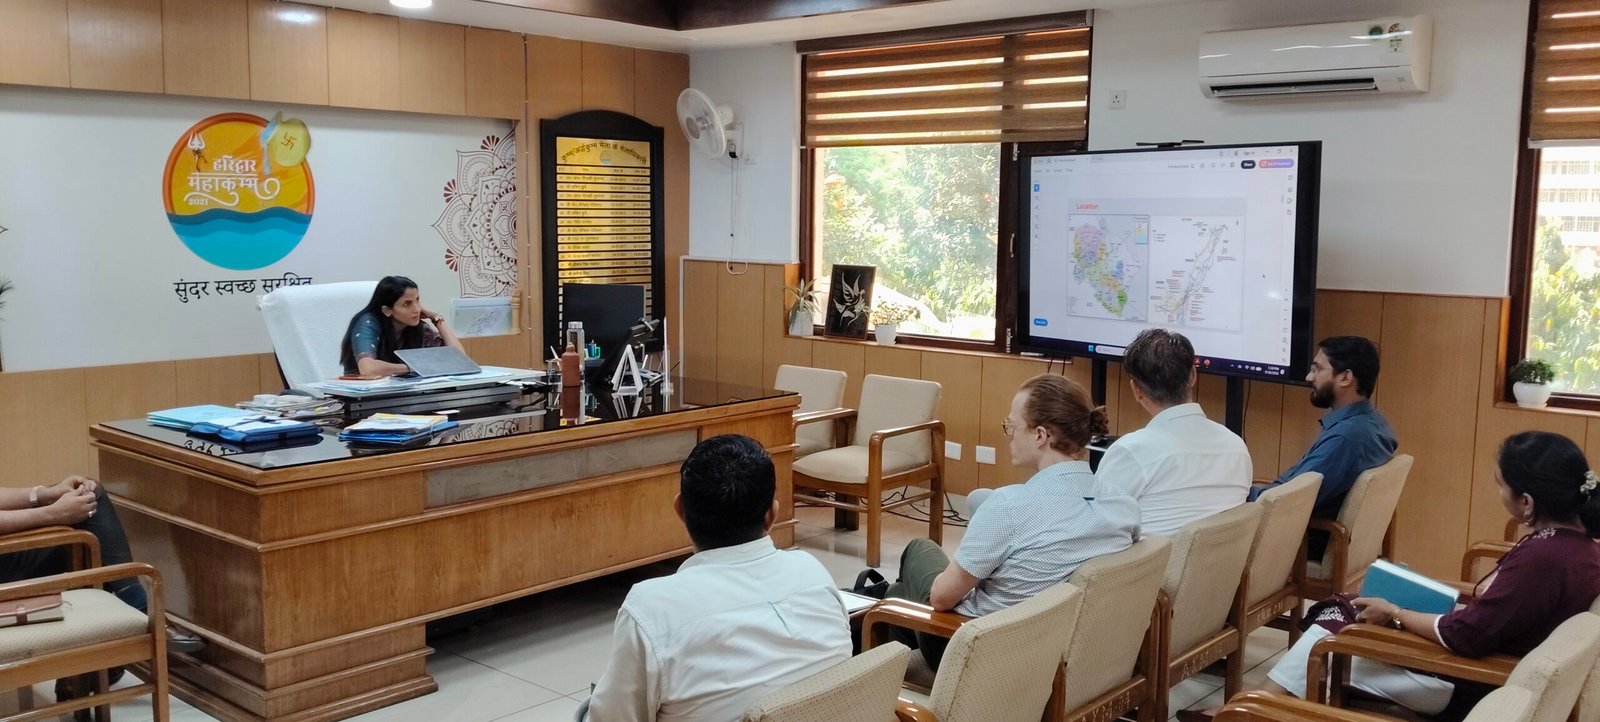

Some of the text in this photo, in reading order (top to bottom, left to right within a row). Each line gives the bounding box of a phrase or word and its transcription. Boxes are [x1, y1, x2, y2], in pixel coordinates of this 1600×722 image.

[213, 155, 256, 174] हरिद्वार
[187, 197, 209, 206] 2021
[173, 271, 313, 303] सुंदर स्वच्छ सरक्षित
